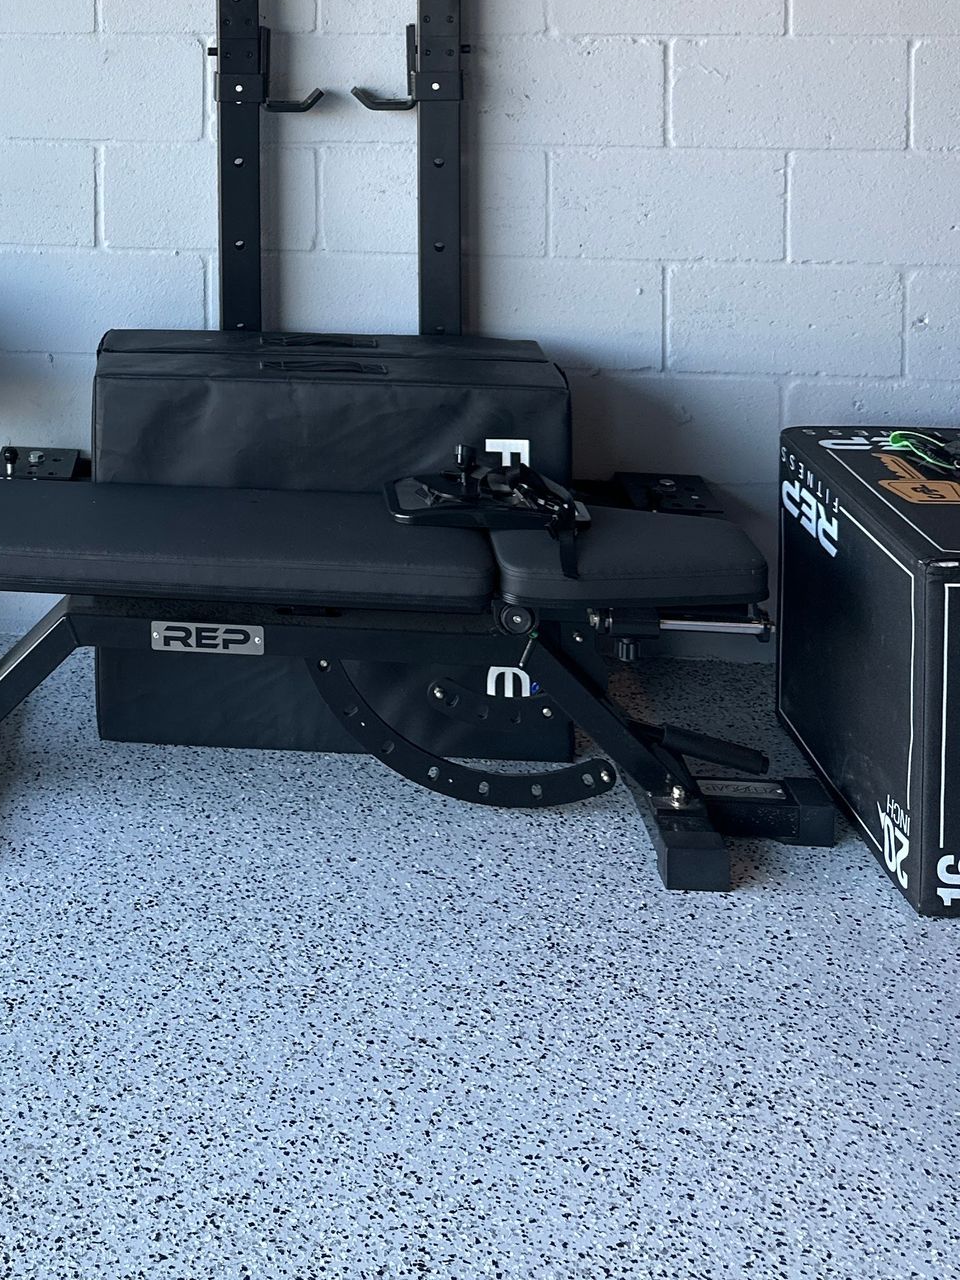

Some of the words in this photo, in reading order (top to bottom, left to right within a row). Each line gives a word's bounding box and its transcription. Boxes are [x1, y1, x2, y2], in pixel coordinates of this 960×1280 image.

[781, 446, 839, 513] FITNESS
[782, 480, 838, 558] REP
[162, 625, 251, 650] REP
[887, 794, 910, 836] INCH
[884, 812, 910, 889] 20
